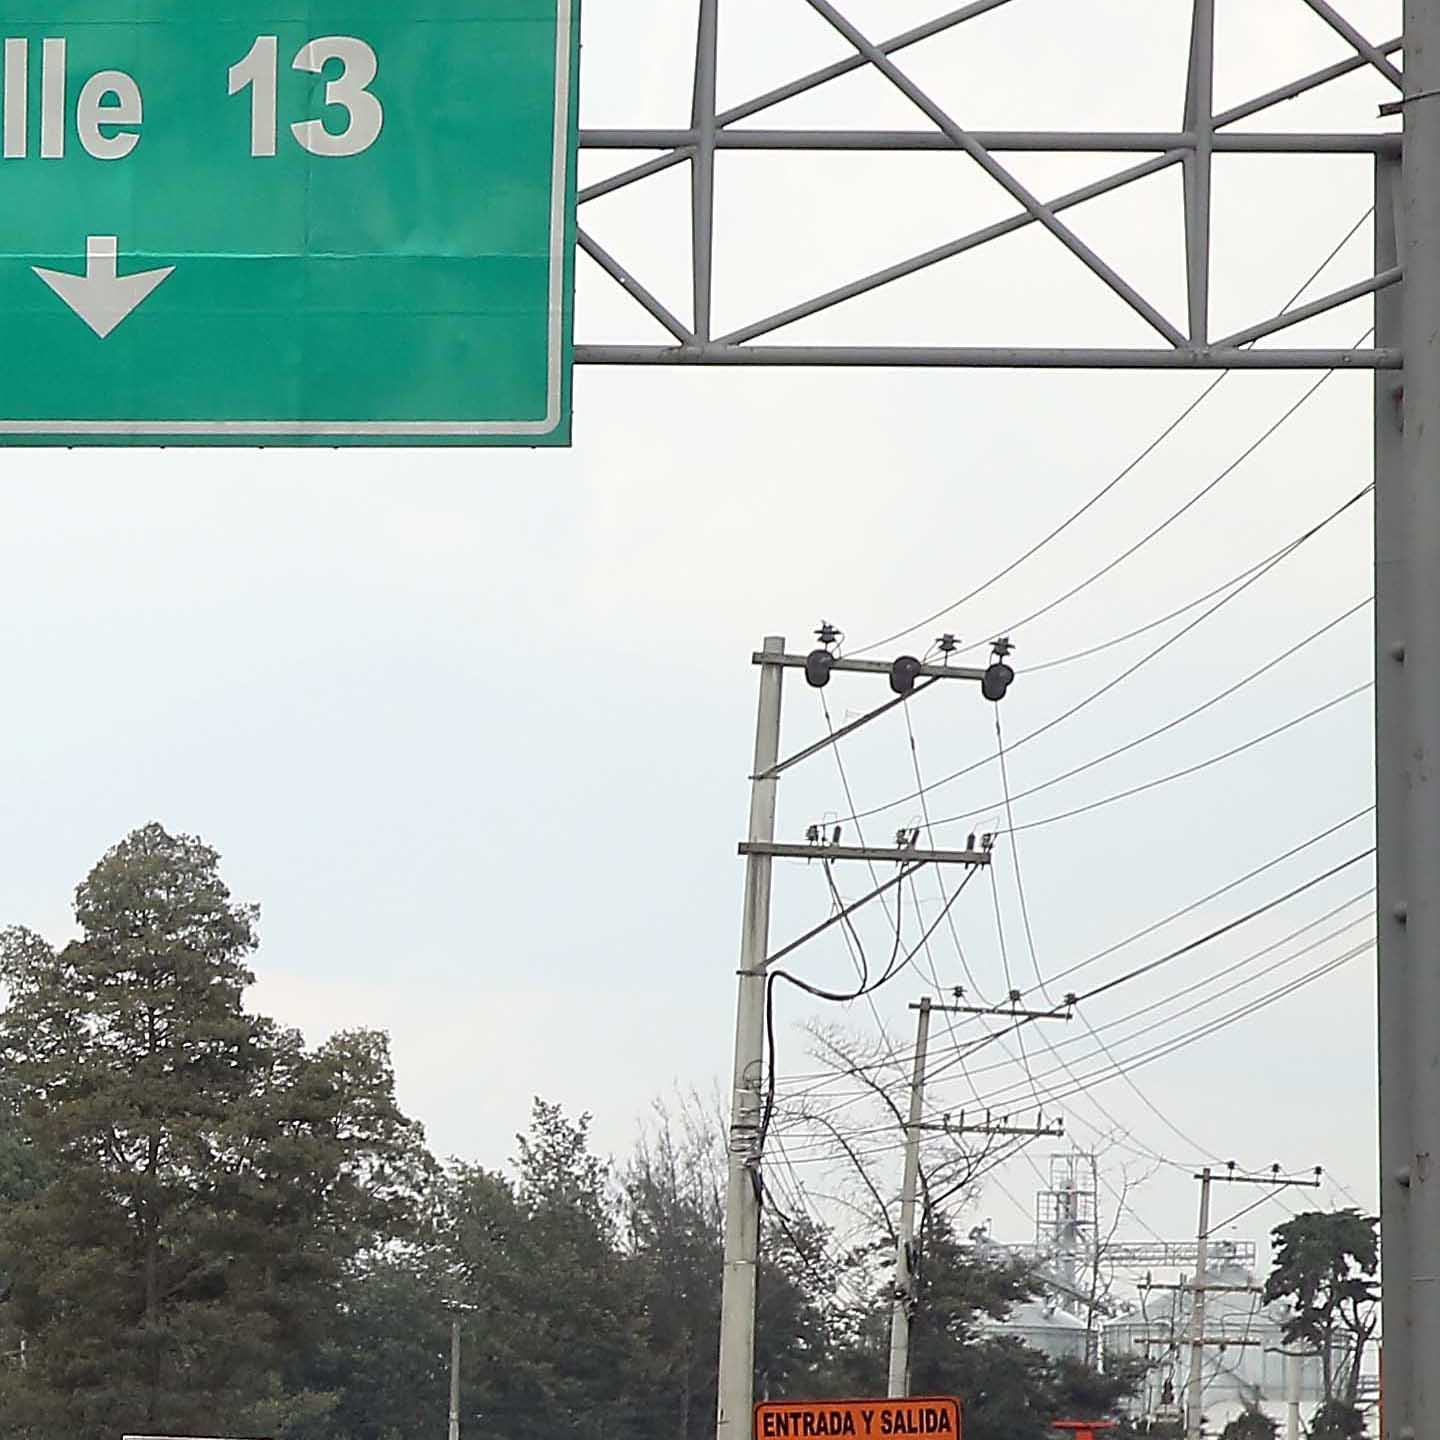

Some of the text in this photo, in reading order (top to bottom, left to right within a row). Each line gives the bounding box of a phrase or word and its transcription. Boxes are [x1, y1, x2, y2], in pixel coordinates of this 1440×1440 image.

[227, 34, 384, 157] 13
[763, 1407, 952, 1437] ENTRADA Y SALIDA
